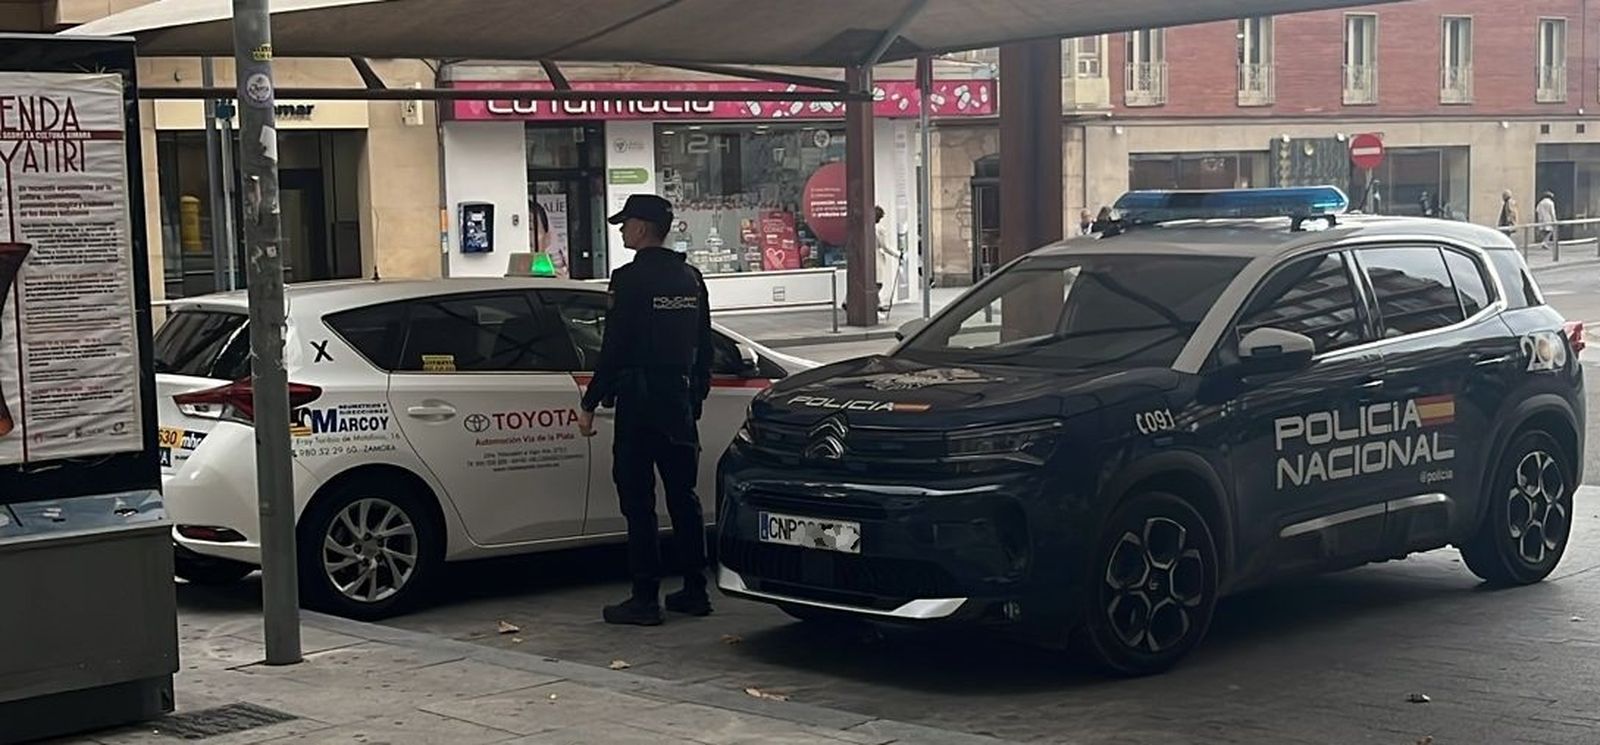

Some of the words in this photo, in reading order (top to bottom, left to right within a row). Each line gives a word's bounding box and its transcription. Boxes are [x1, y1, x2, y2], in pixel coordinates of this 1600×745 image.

[310, 340, 334, 363] X
[492, 409, 578, 430] TOYOTA
[1276, 431, 1455, 489] NACIONAL
